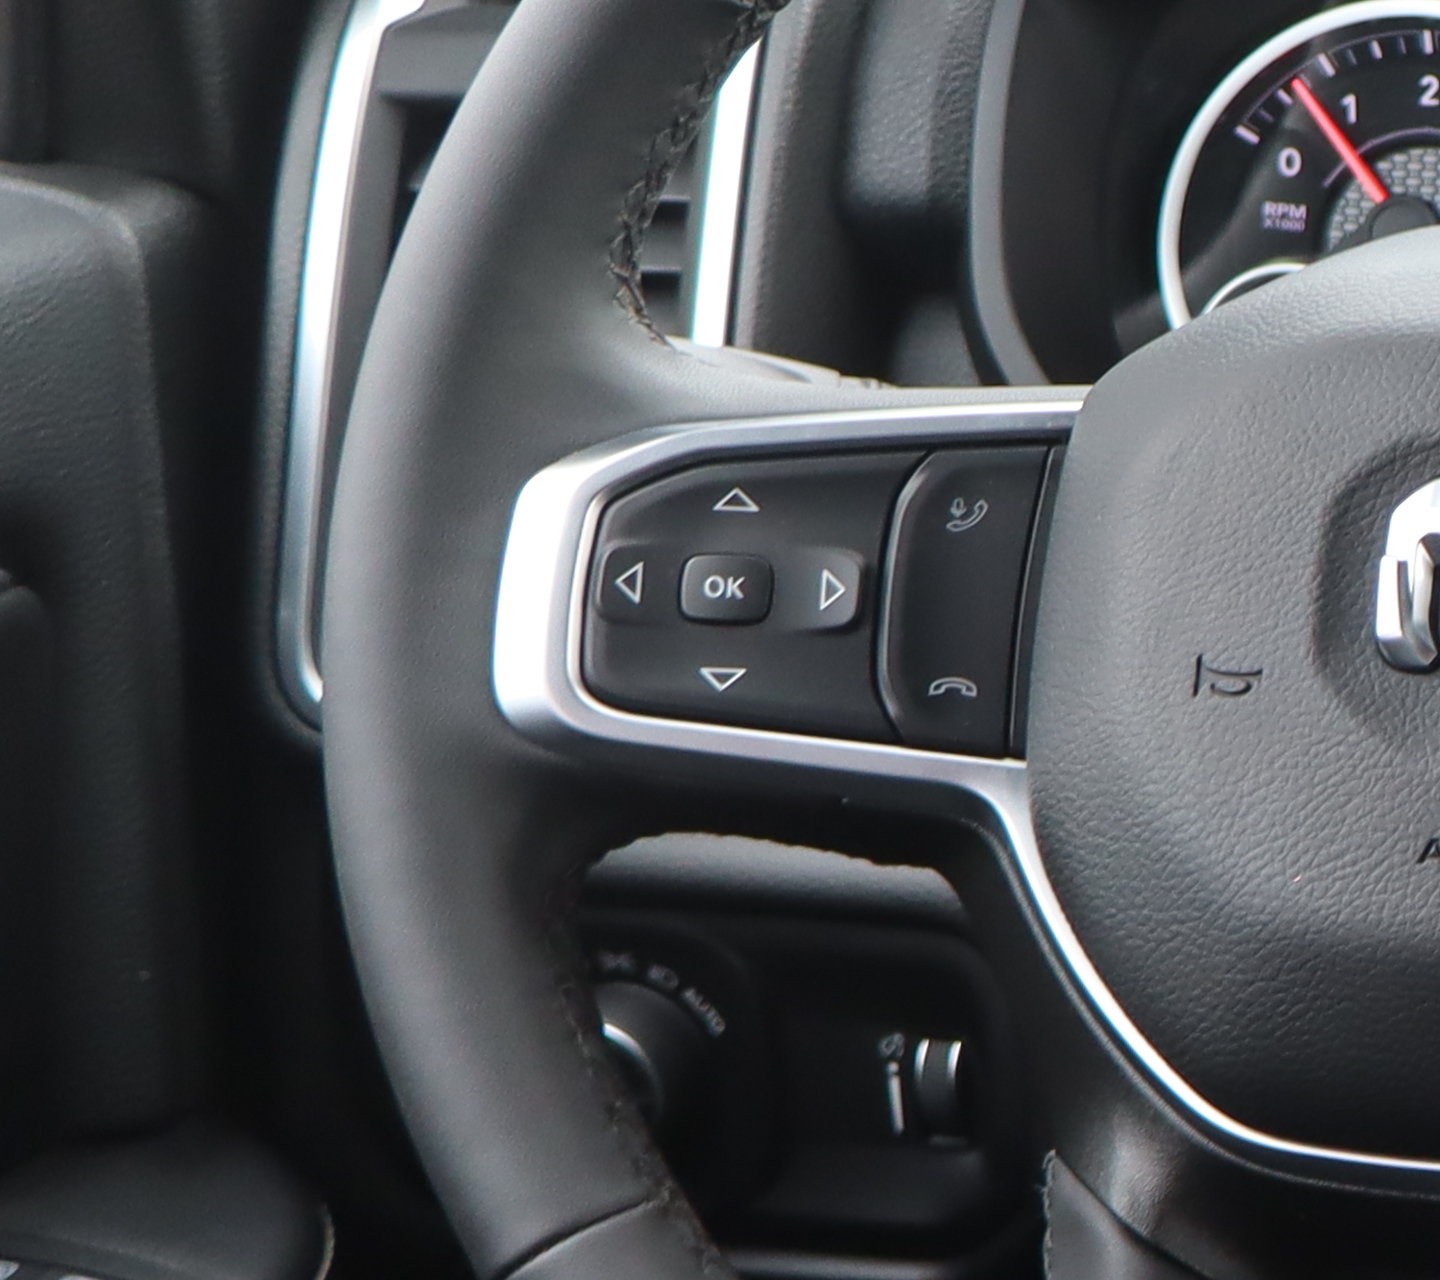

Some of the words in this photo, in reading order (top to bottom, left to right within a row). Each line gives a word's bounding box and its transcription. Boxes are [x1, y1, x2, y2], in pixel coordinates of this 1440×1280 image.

[1418, 75, 1440, 107] 2
[1341, 93, 1358, 123] 1
[1278, 147, 1302, 178] 0
[1264, 201, 1307, 219] RPM
[704, 575, 745, 599] OK
